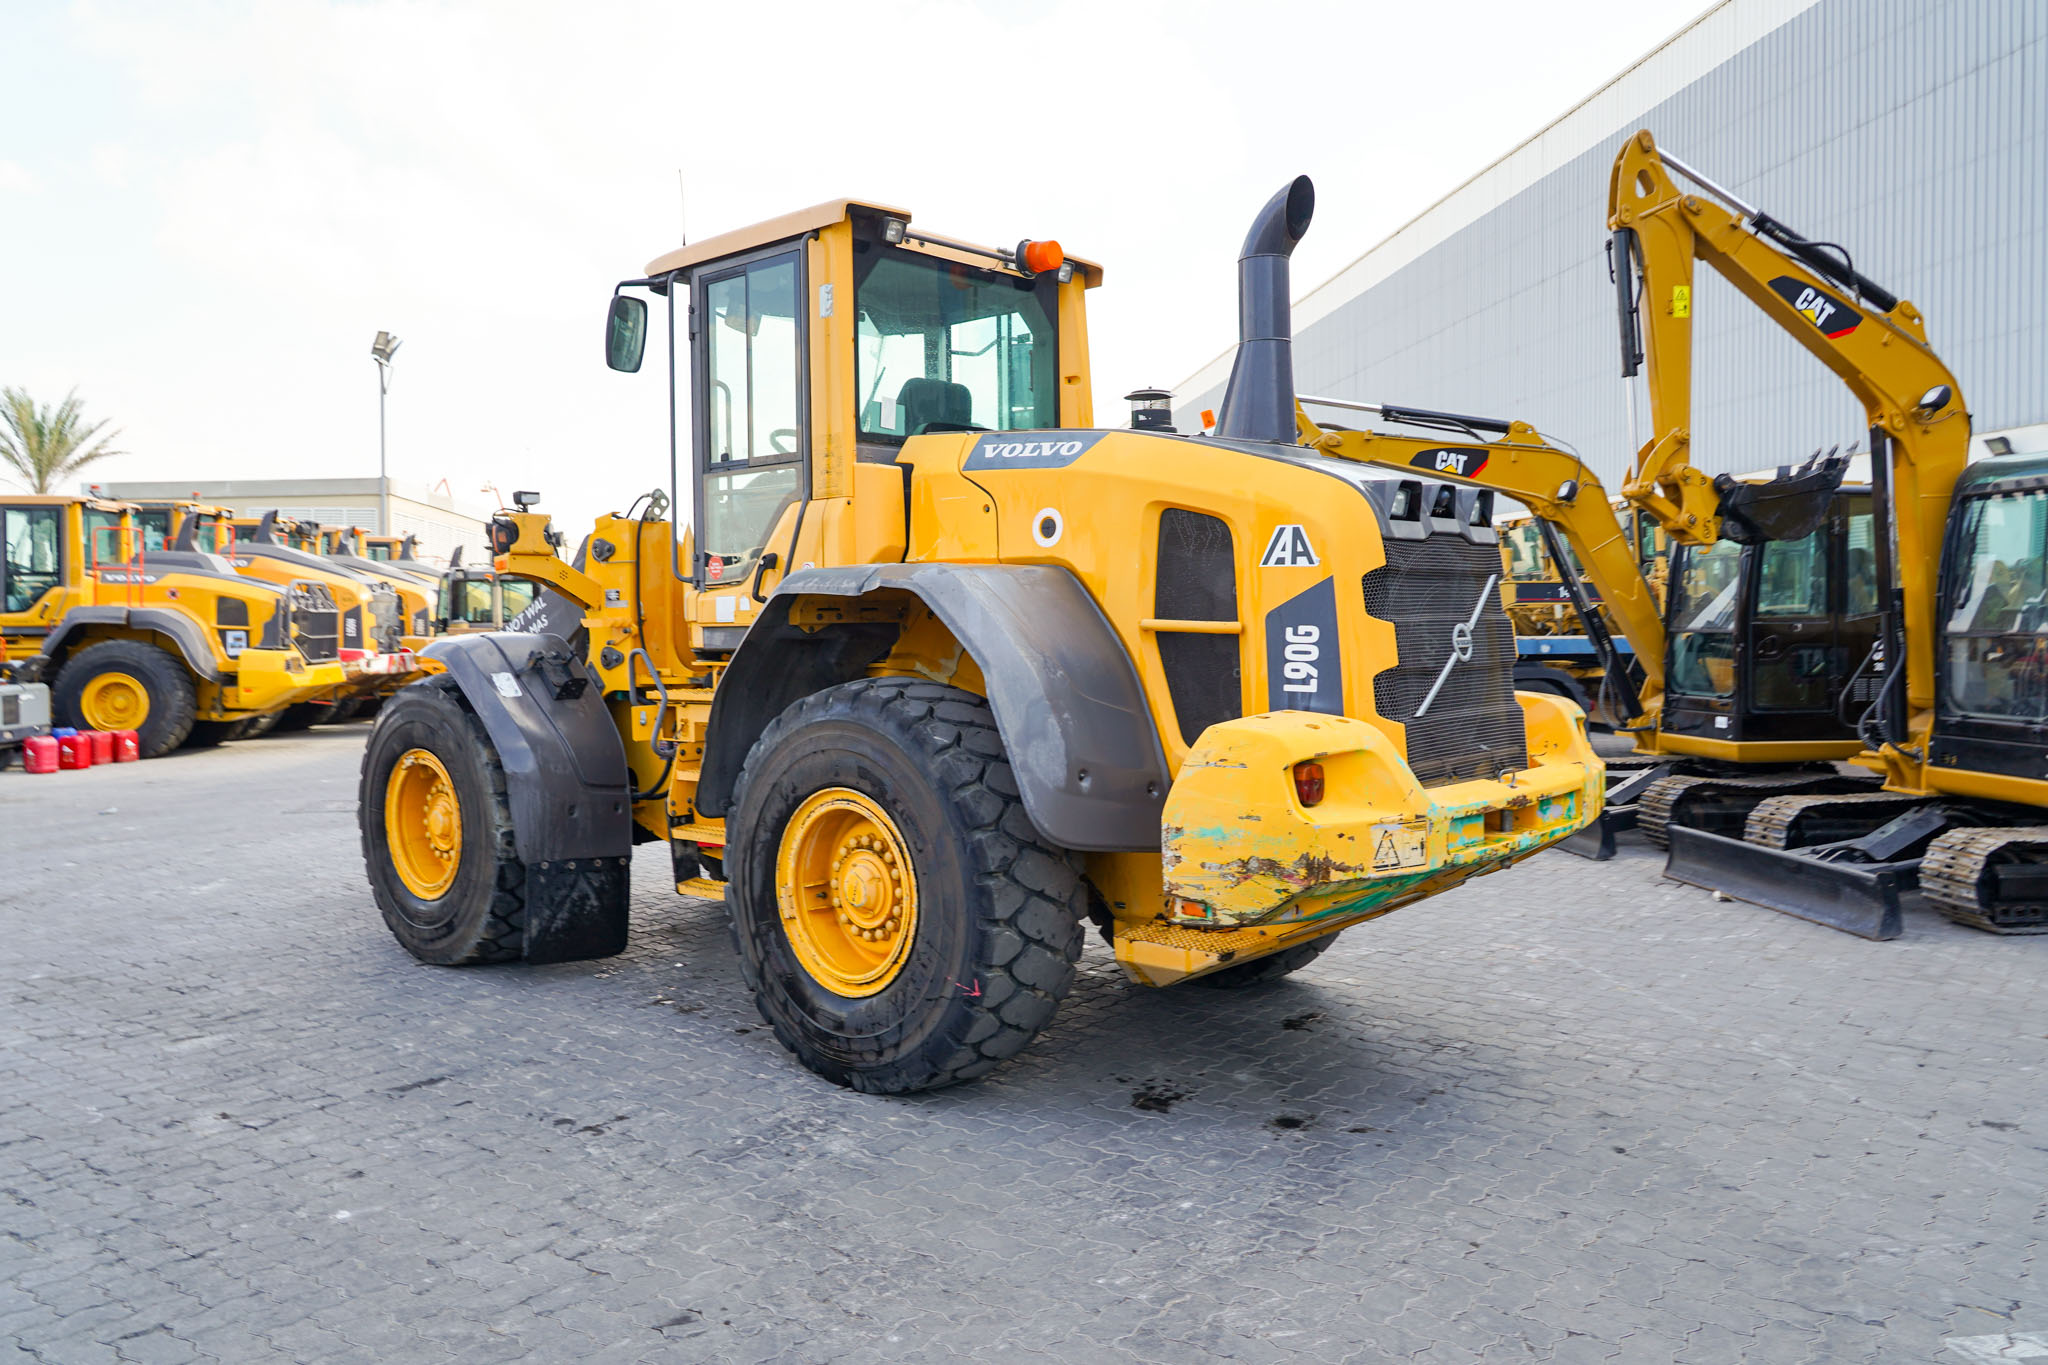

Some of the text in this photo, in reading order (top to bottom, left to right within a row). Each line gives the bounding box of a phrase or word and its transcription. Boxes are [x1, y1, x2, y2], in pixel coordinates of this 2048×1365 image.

[1794, 287, 1837, 328] CAT
[983, 441, 1083, 459] VOLVO
[1435, 450, 1469, 475] CAT
[1282, 624, 1321, 693] L90G
